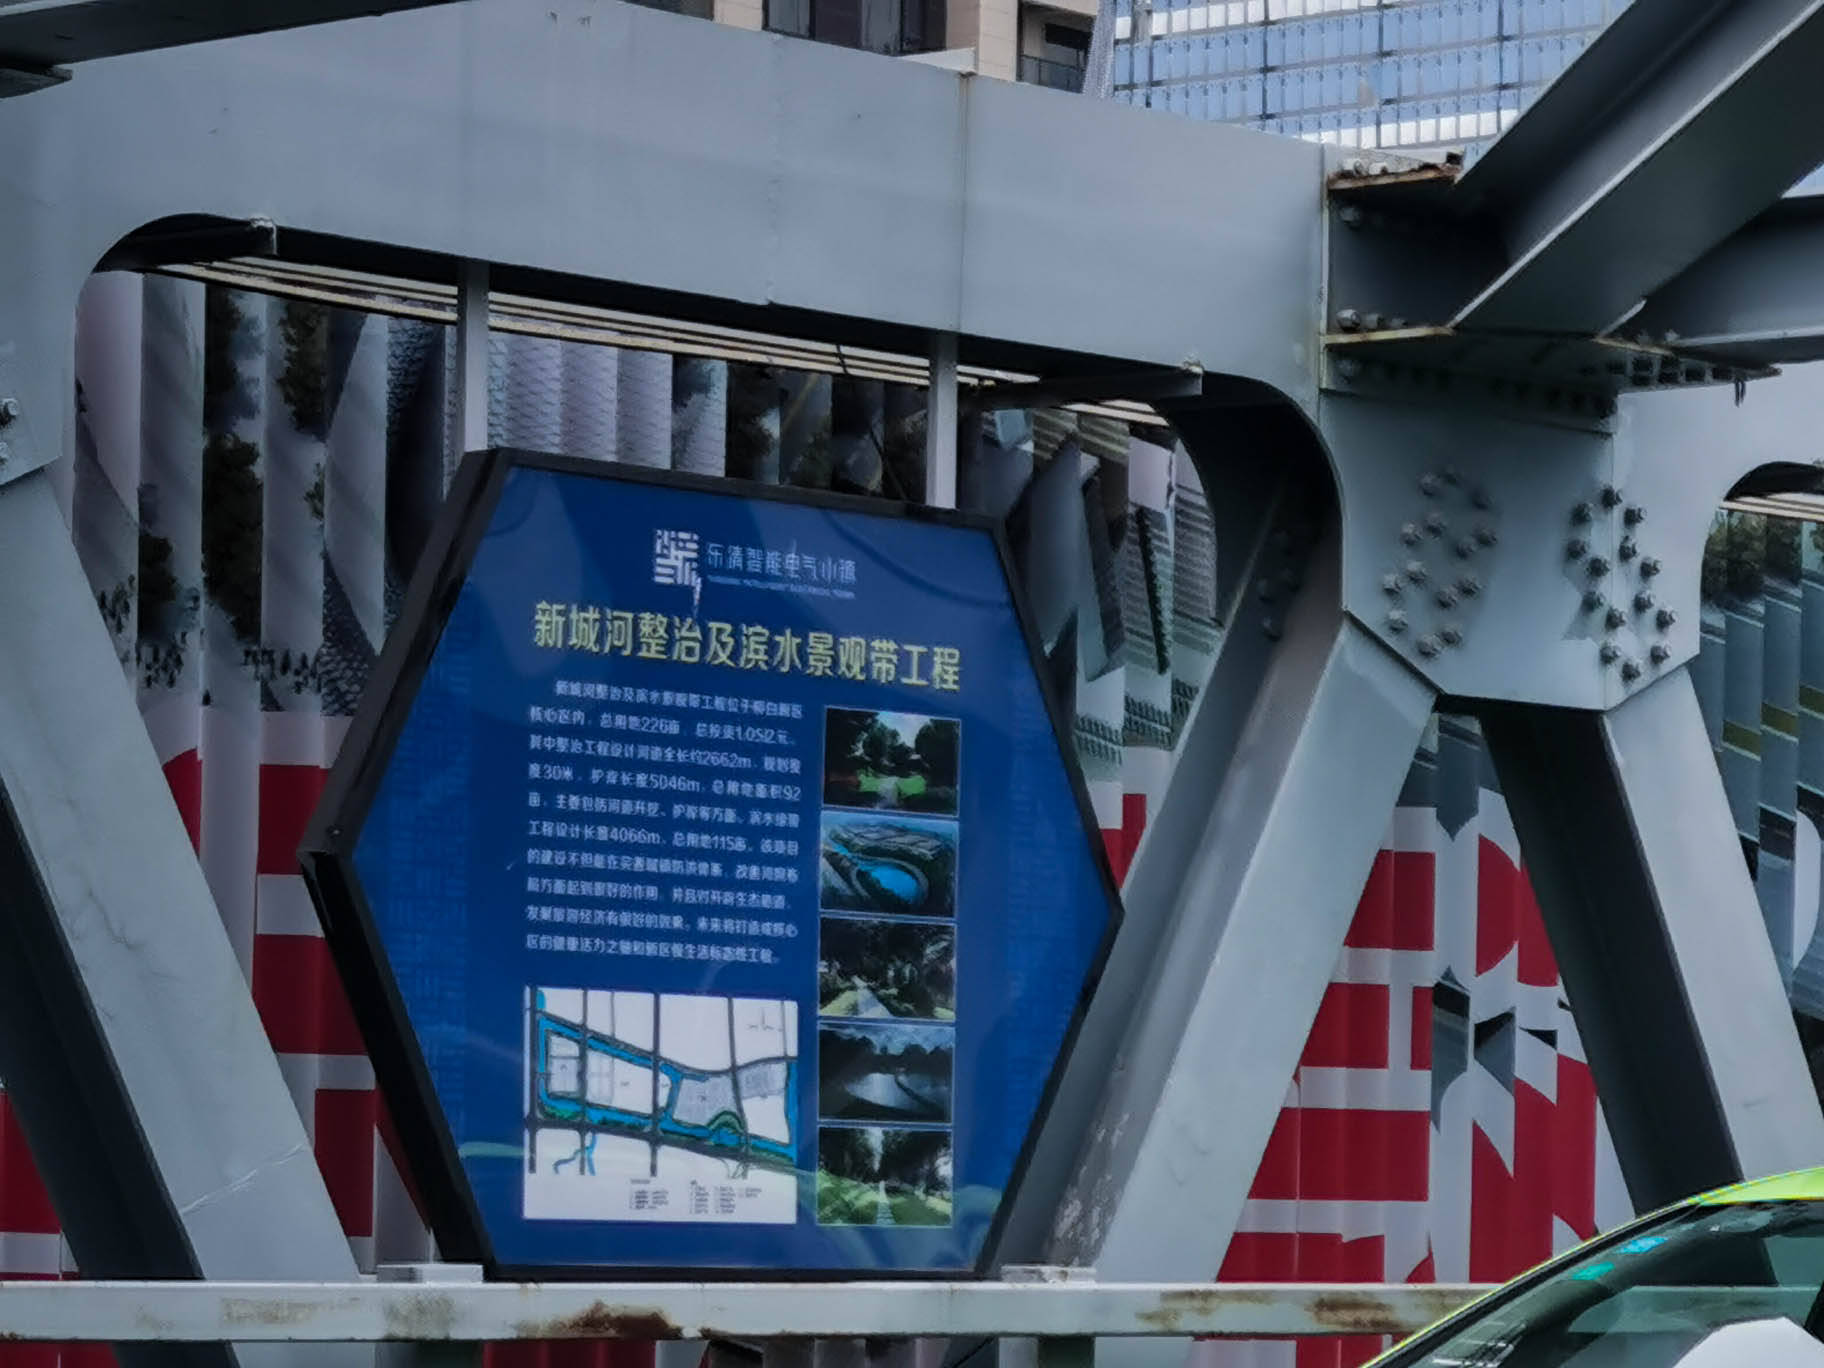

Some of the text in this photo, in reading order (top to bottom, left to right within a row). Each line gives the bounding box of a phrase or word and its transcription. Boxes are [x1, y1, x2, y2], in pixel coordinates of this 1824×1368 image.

[534, 600, 961, 691] 新城河整治及滨水景观带工程
